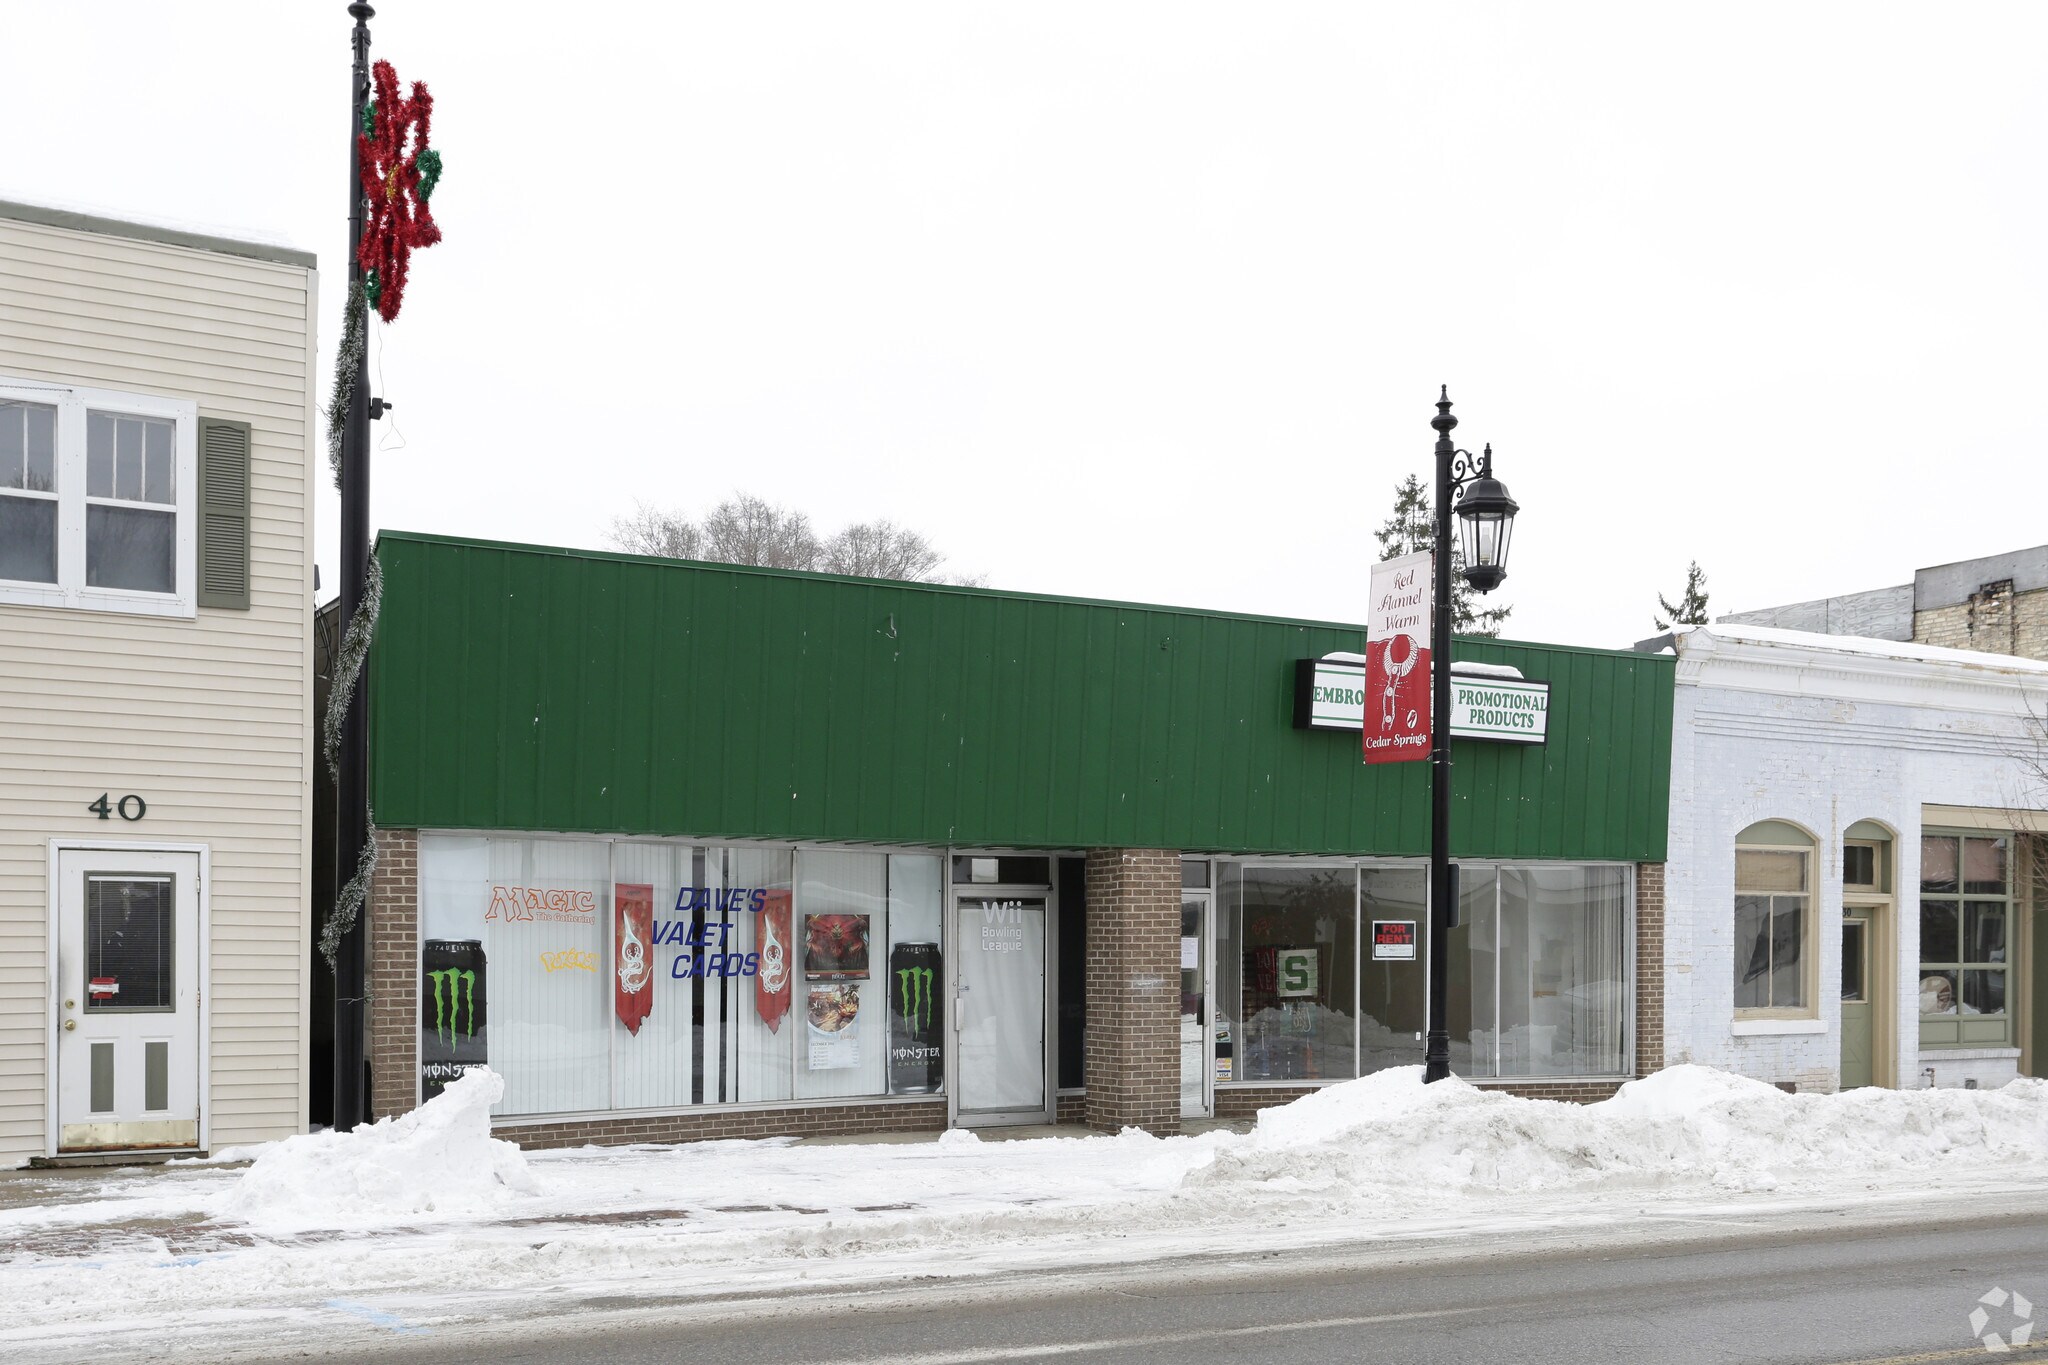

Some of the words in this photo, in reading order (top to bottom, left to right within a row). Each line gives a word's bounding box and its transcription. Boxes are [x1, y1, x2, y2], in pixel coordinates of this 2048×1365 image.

[1393, 569, 1414, 590] Red
[1377, 588, 1422, 612] Flannel
[1458, 689, 1547, 711] PROMOTIONAL
[1469, 709, 1535, 728] PRODUCTS
[1366, 735, 1391, 748] Cedar
[1393, 732, 1427, 748] Springs
[88, 792, 146, 821] 40
[675, 887, 767, 912] DAVE'S
[536, 911, 552, 921] The
[553, 912, 595, 925] Gathering
[982, 900, 1022, 924] Wii
[652, 920, 734, 947] VALET
[982, 926, 1022, 940] Bowling
[1376, 934, 1412, 944] RENT
[1382, 924, 1406, 934] FOR
[982, 939, 1022, 953] League
[671, 953, 760, 979] CARDS
[1285, 955, 1308, 991] S
[893, 1046, 940, 1060] MONSTER
[422, 1062, 487, 1079] MONS
